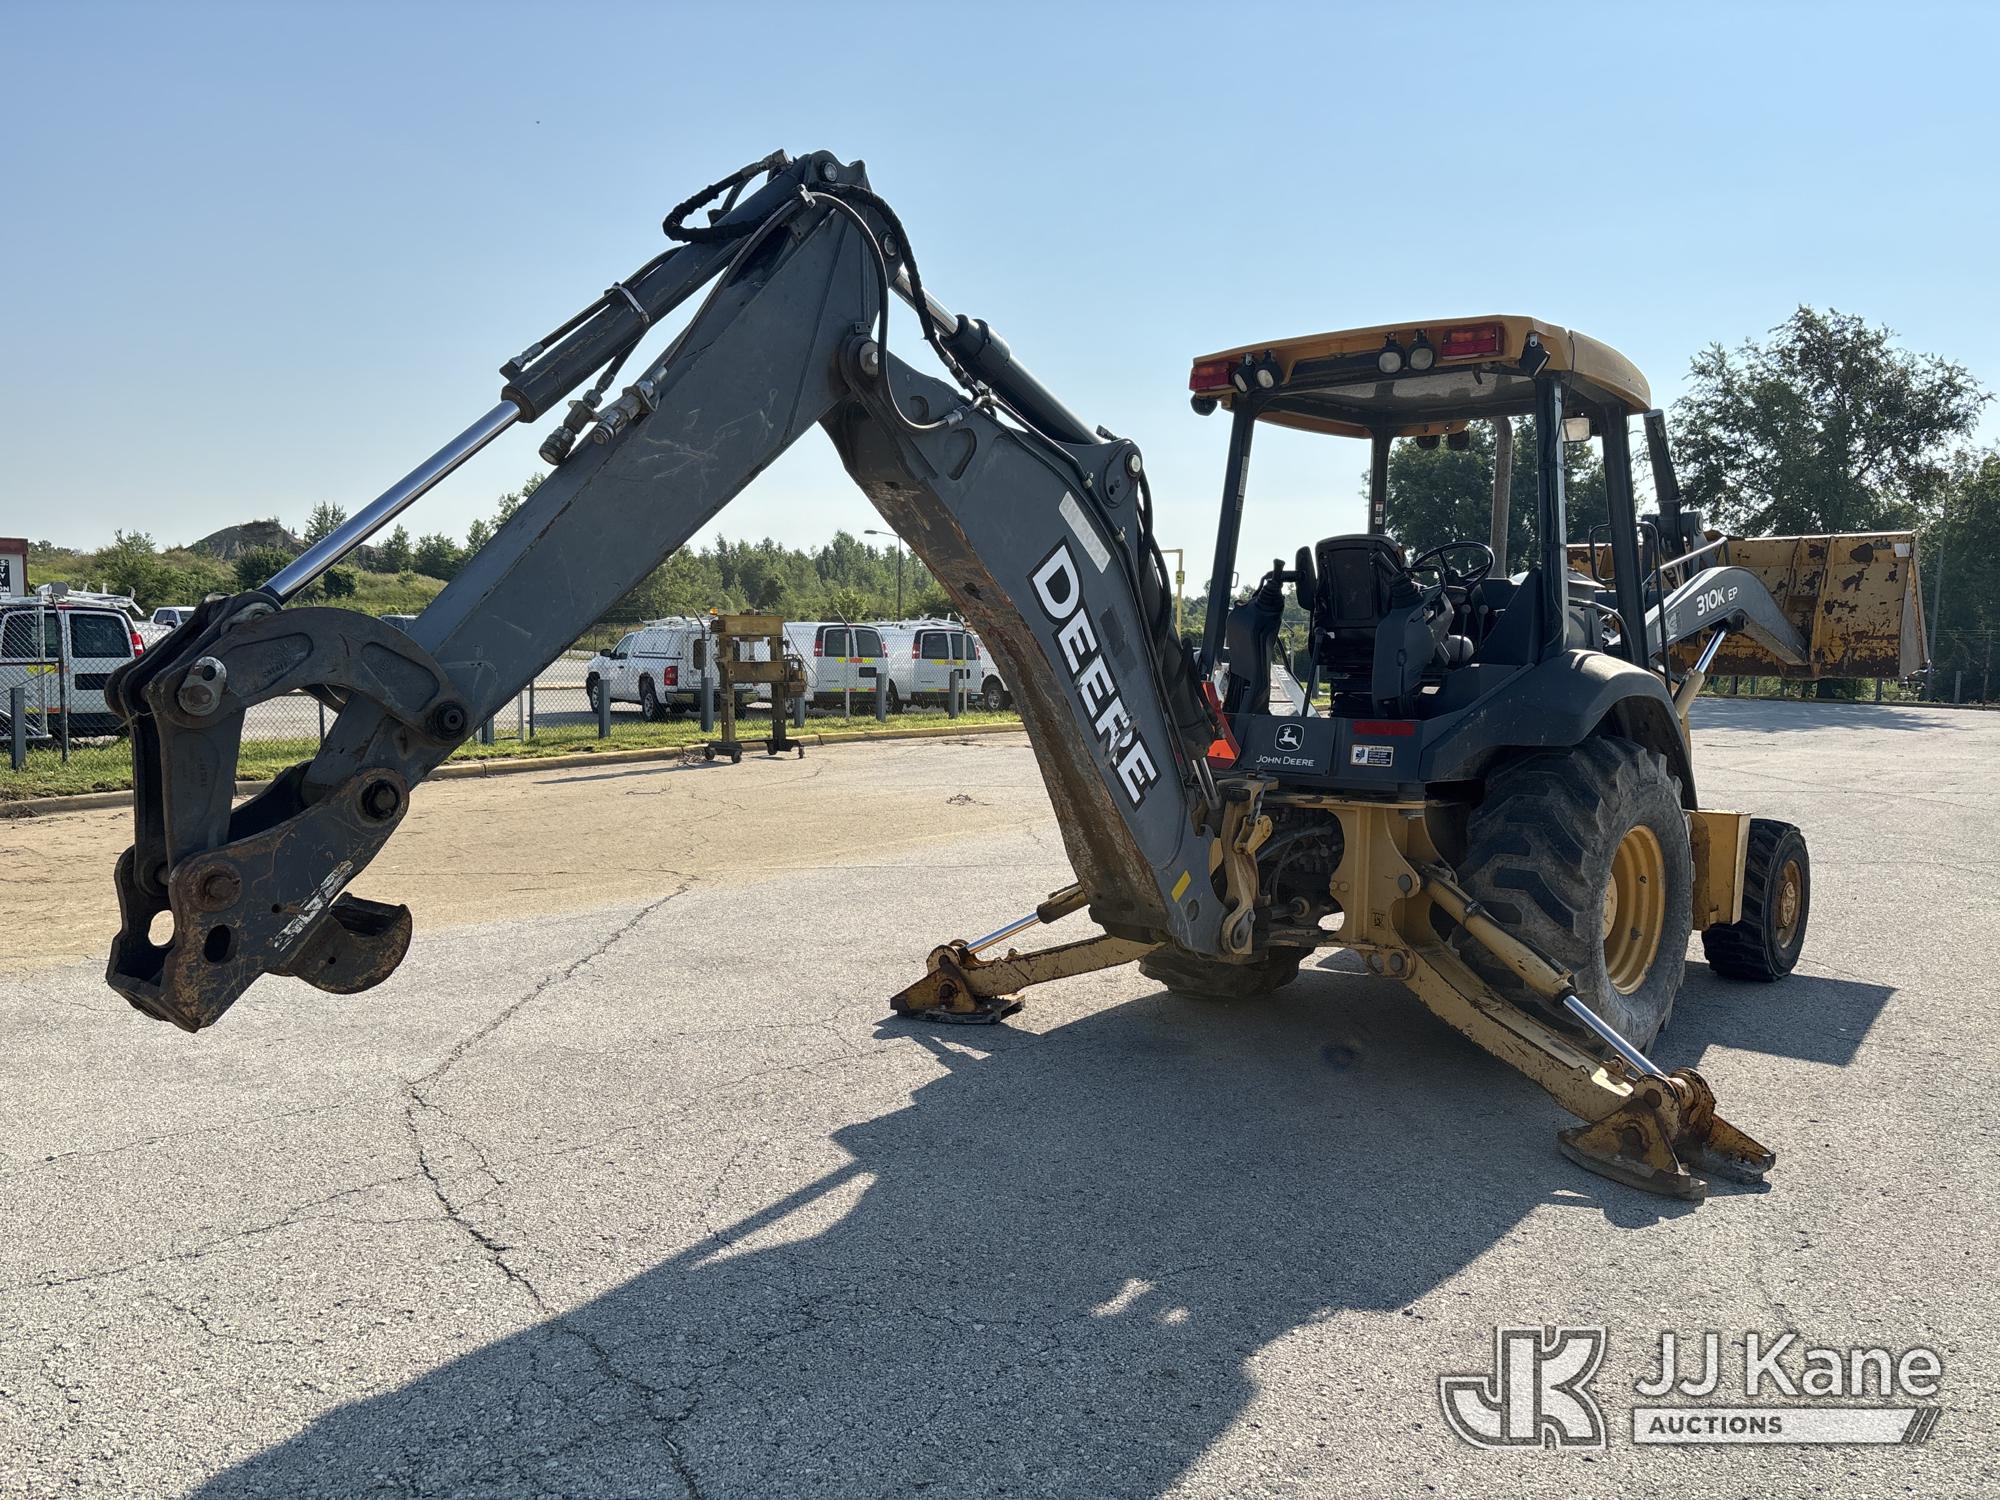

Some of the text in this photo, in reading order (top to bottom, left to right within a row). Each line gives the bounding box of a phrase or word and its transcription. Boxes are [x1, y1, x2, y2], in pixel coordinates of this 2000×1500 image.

[1696, 586, 1738, 617] 310K EP
[1032, 545, 1158, 804] DEERE
[1256, 755, 1315, 766] JOHN DEERE
